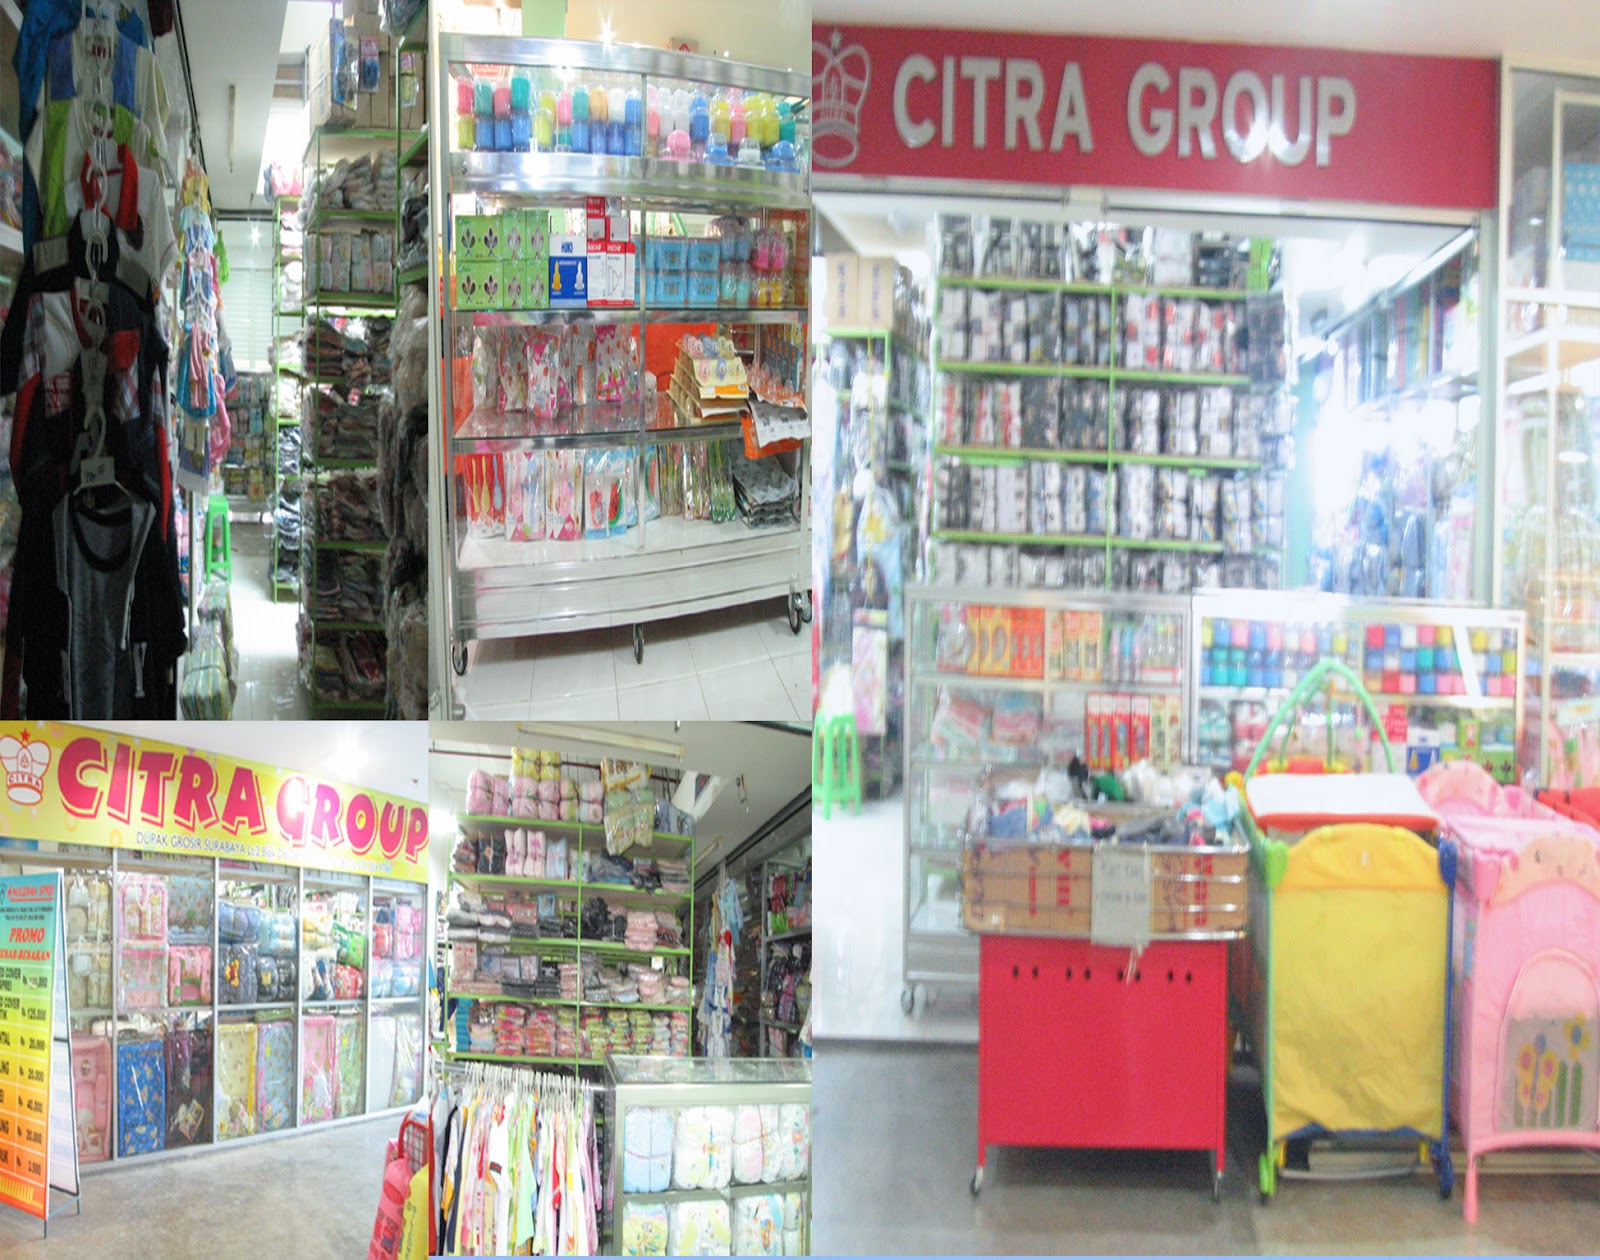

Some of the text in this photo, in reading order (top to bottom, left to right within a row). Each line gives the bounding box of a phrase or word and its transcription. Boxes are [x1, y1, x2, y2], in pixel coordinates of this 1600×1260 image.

[893, 54, 1356, 167] CITRA GROUP
[58, 737, 428, 864] CITRA GROUP
[136, 831, 168, 847] DUPAK
[170, 835, 202, 850] GROSIR
[204, 838, 246, 855] SURABAYA
[9, 927, 46, 943] PROMO
